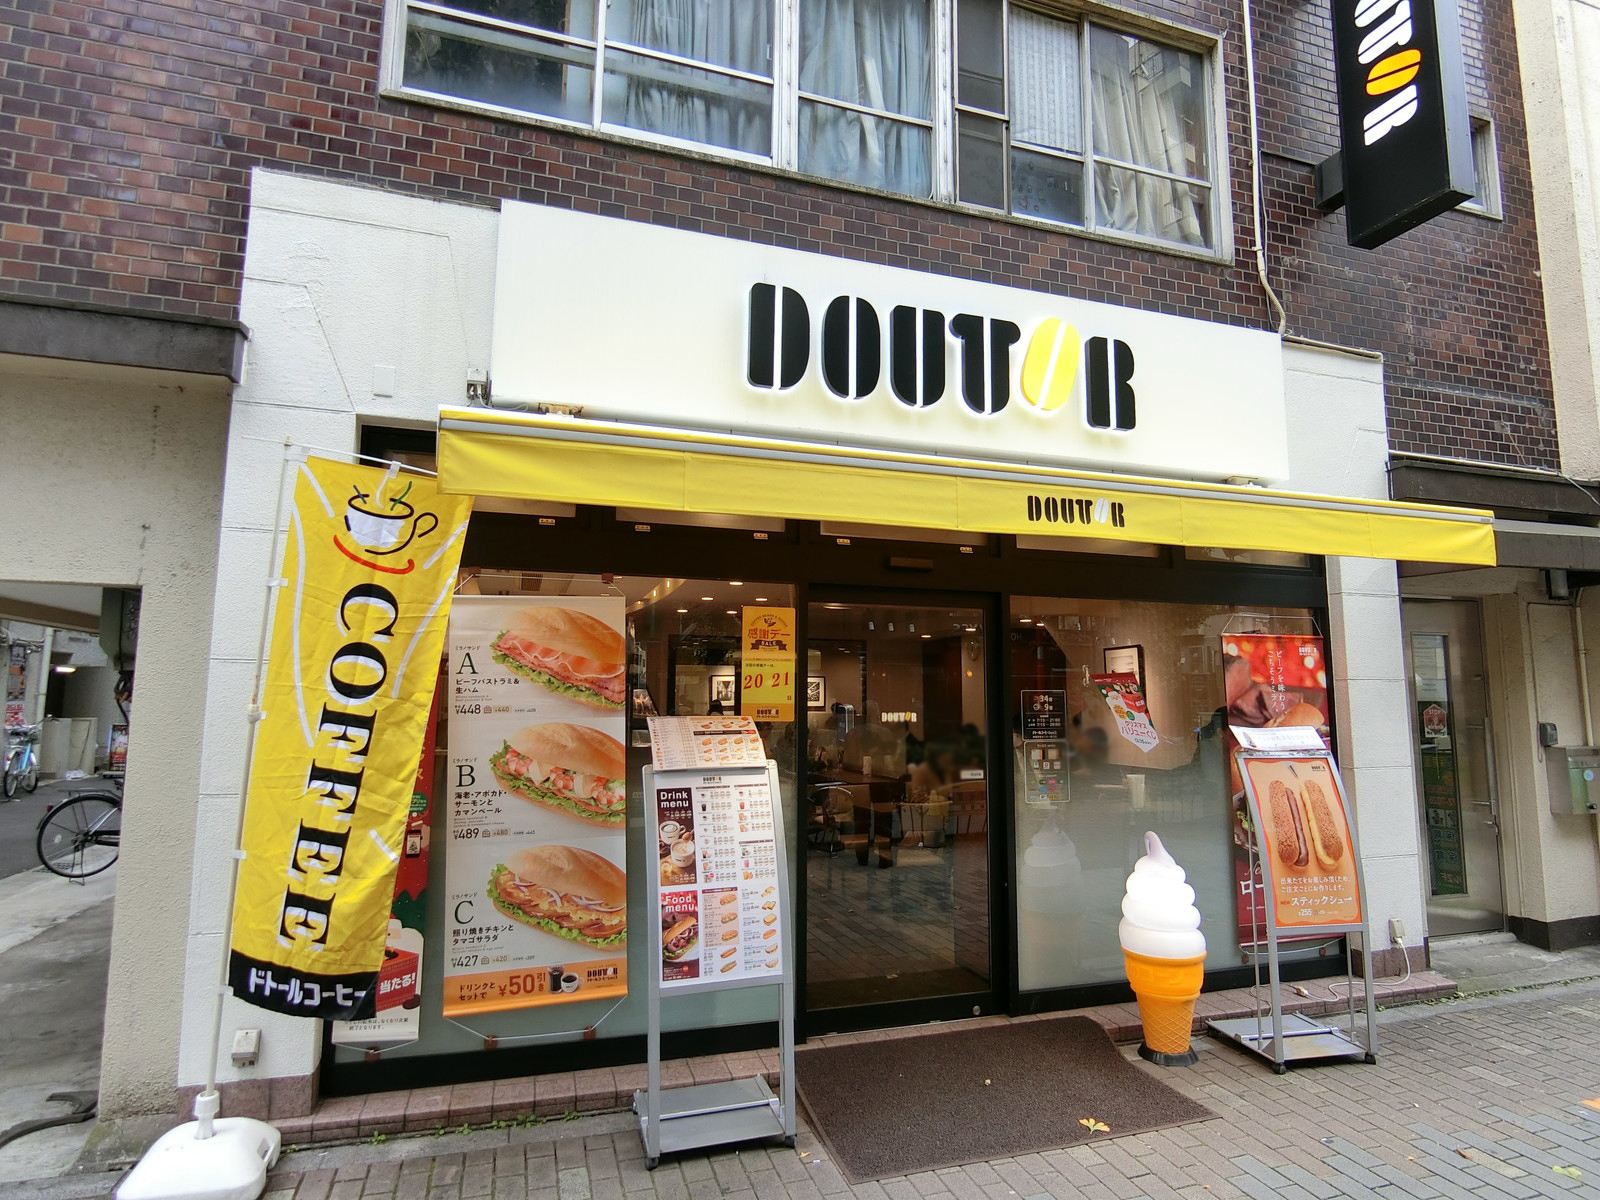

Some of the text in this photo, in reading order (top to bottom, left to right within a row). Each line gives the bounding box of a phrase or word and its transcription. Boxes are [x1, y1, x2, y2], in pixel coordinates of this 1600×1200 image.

[747, 282, 1136, 431] DOUTOR
[1027, 495, 1125, 528] DOUTOR
[748, 628, 790, 639] 感謝デー
[456, 652, 479, 675] A
[743, 672, 789, 690] 20 21
[455, 686, 479, 694] 生ハム
[456, 704, 481, 715] ¥448
[881, 711, 917, 722] DOUTOR
[278, 583, 399, 948] COFFEE
[456, 764, 476, 788] B
[660, 791, 688, 800] Drink
[454, 799, 493, 808] サーモンと
[660, 800, 689, 808] menu
[454, 807, 502, 817] カマンベール
[454, 828, 479, 840] ¥489
[665, 894, 692, 905] Food
[1291, 895, 1353, 906] スティックシュー
[454, 900, 474, 924] C
[665, 903, 695, 913] menu
[453, 934, 500, 946] タマゴサラダ
[452, 955, 479, 968] ¥427
[587, 967, 618, 978] DOUTOR
[248, 967, 367, 1006] ドトールコーヒー
[379, 972, 416, 994] 当たる!
[460, 982, 496, 993] ドリンクと
[498, 973, 536, 997] ¥50
[459, 992, 487, 1001] セットで
